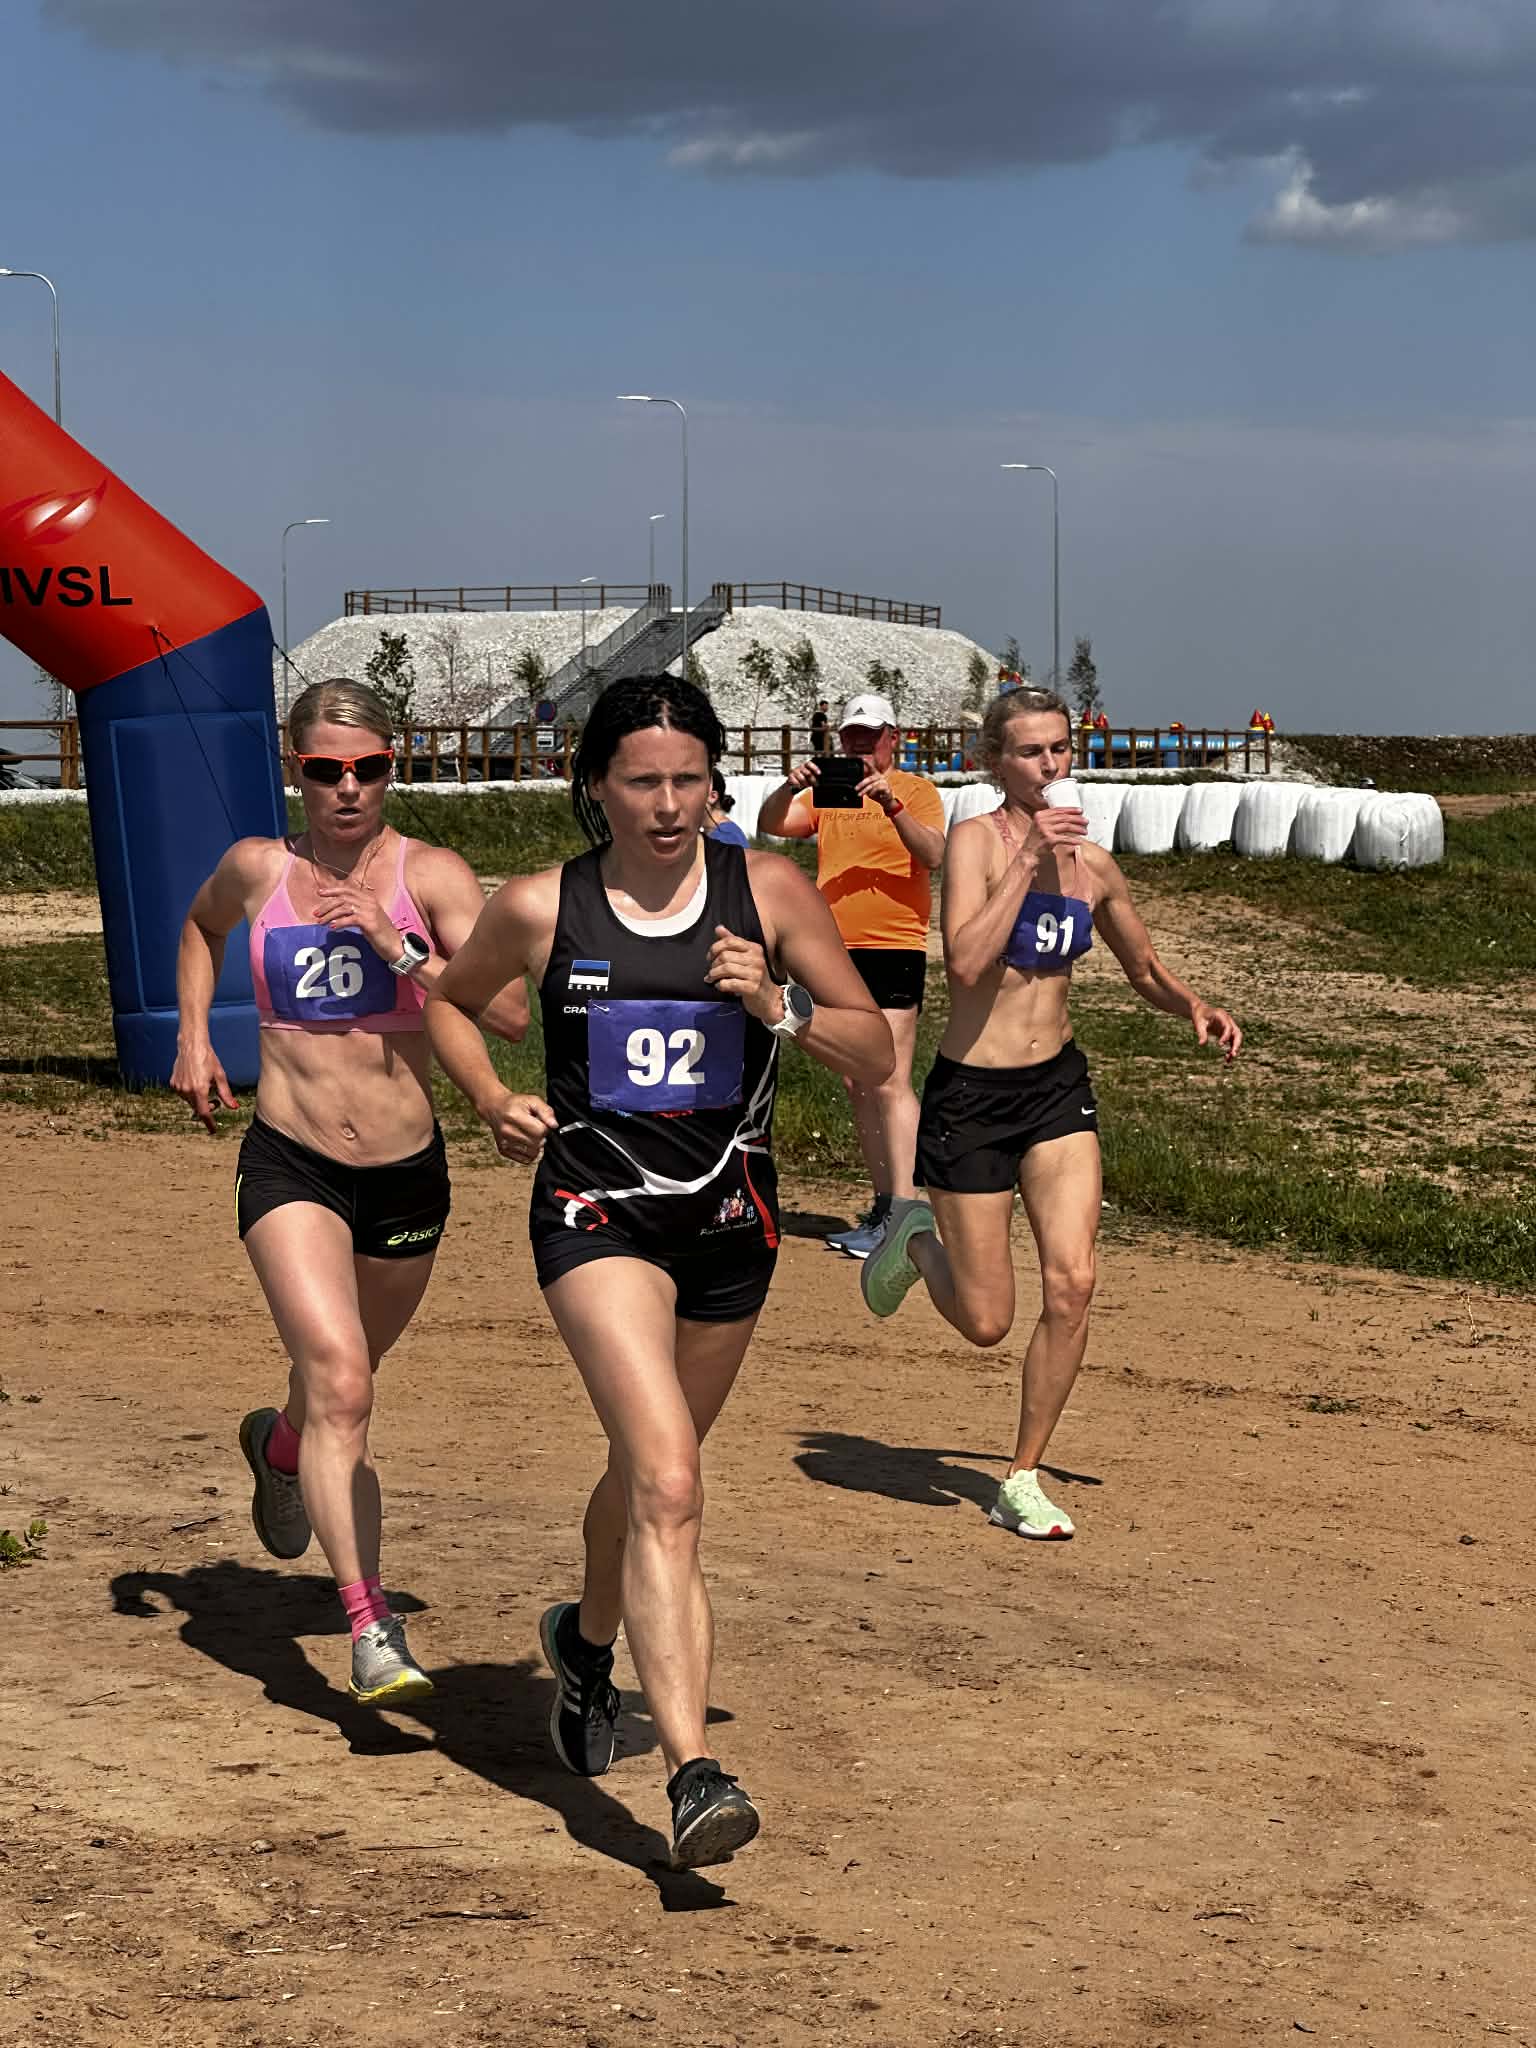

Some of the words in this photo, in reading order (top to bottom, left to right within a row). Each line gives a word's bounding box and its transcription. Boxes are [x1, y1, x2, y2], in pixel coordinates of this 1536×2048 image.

[0, 566, 133, 607] IVSL
[1035, 912, 1074, 956] 91
[294, 945, 364, 998] 26
[567, 983, 609, 992] EESTI
[626, 1028, 706, 1087] 92
